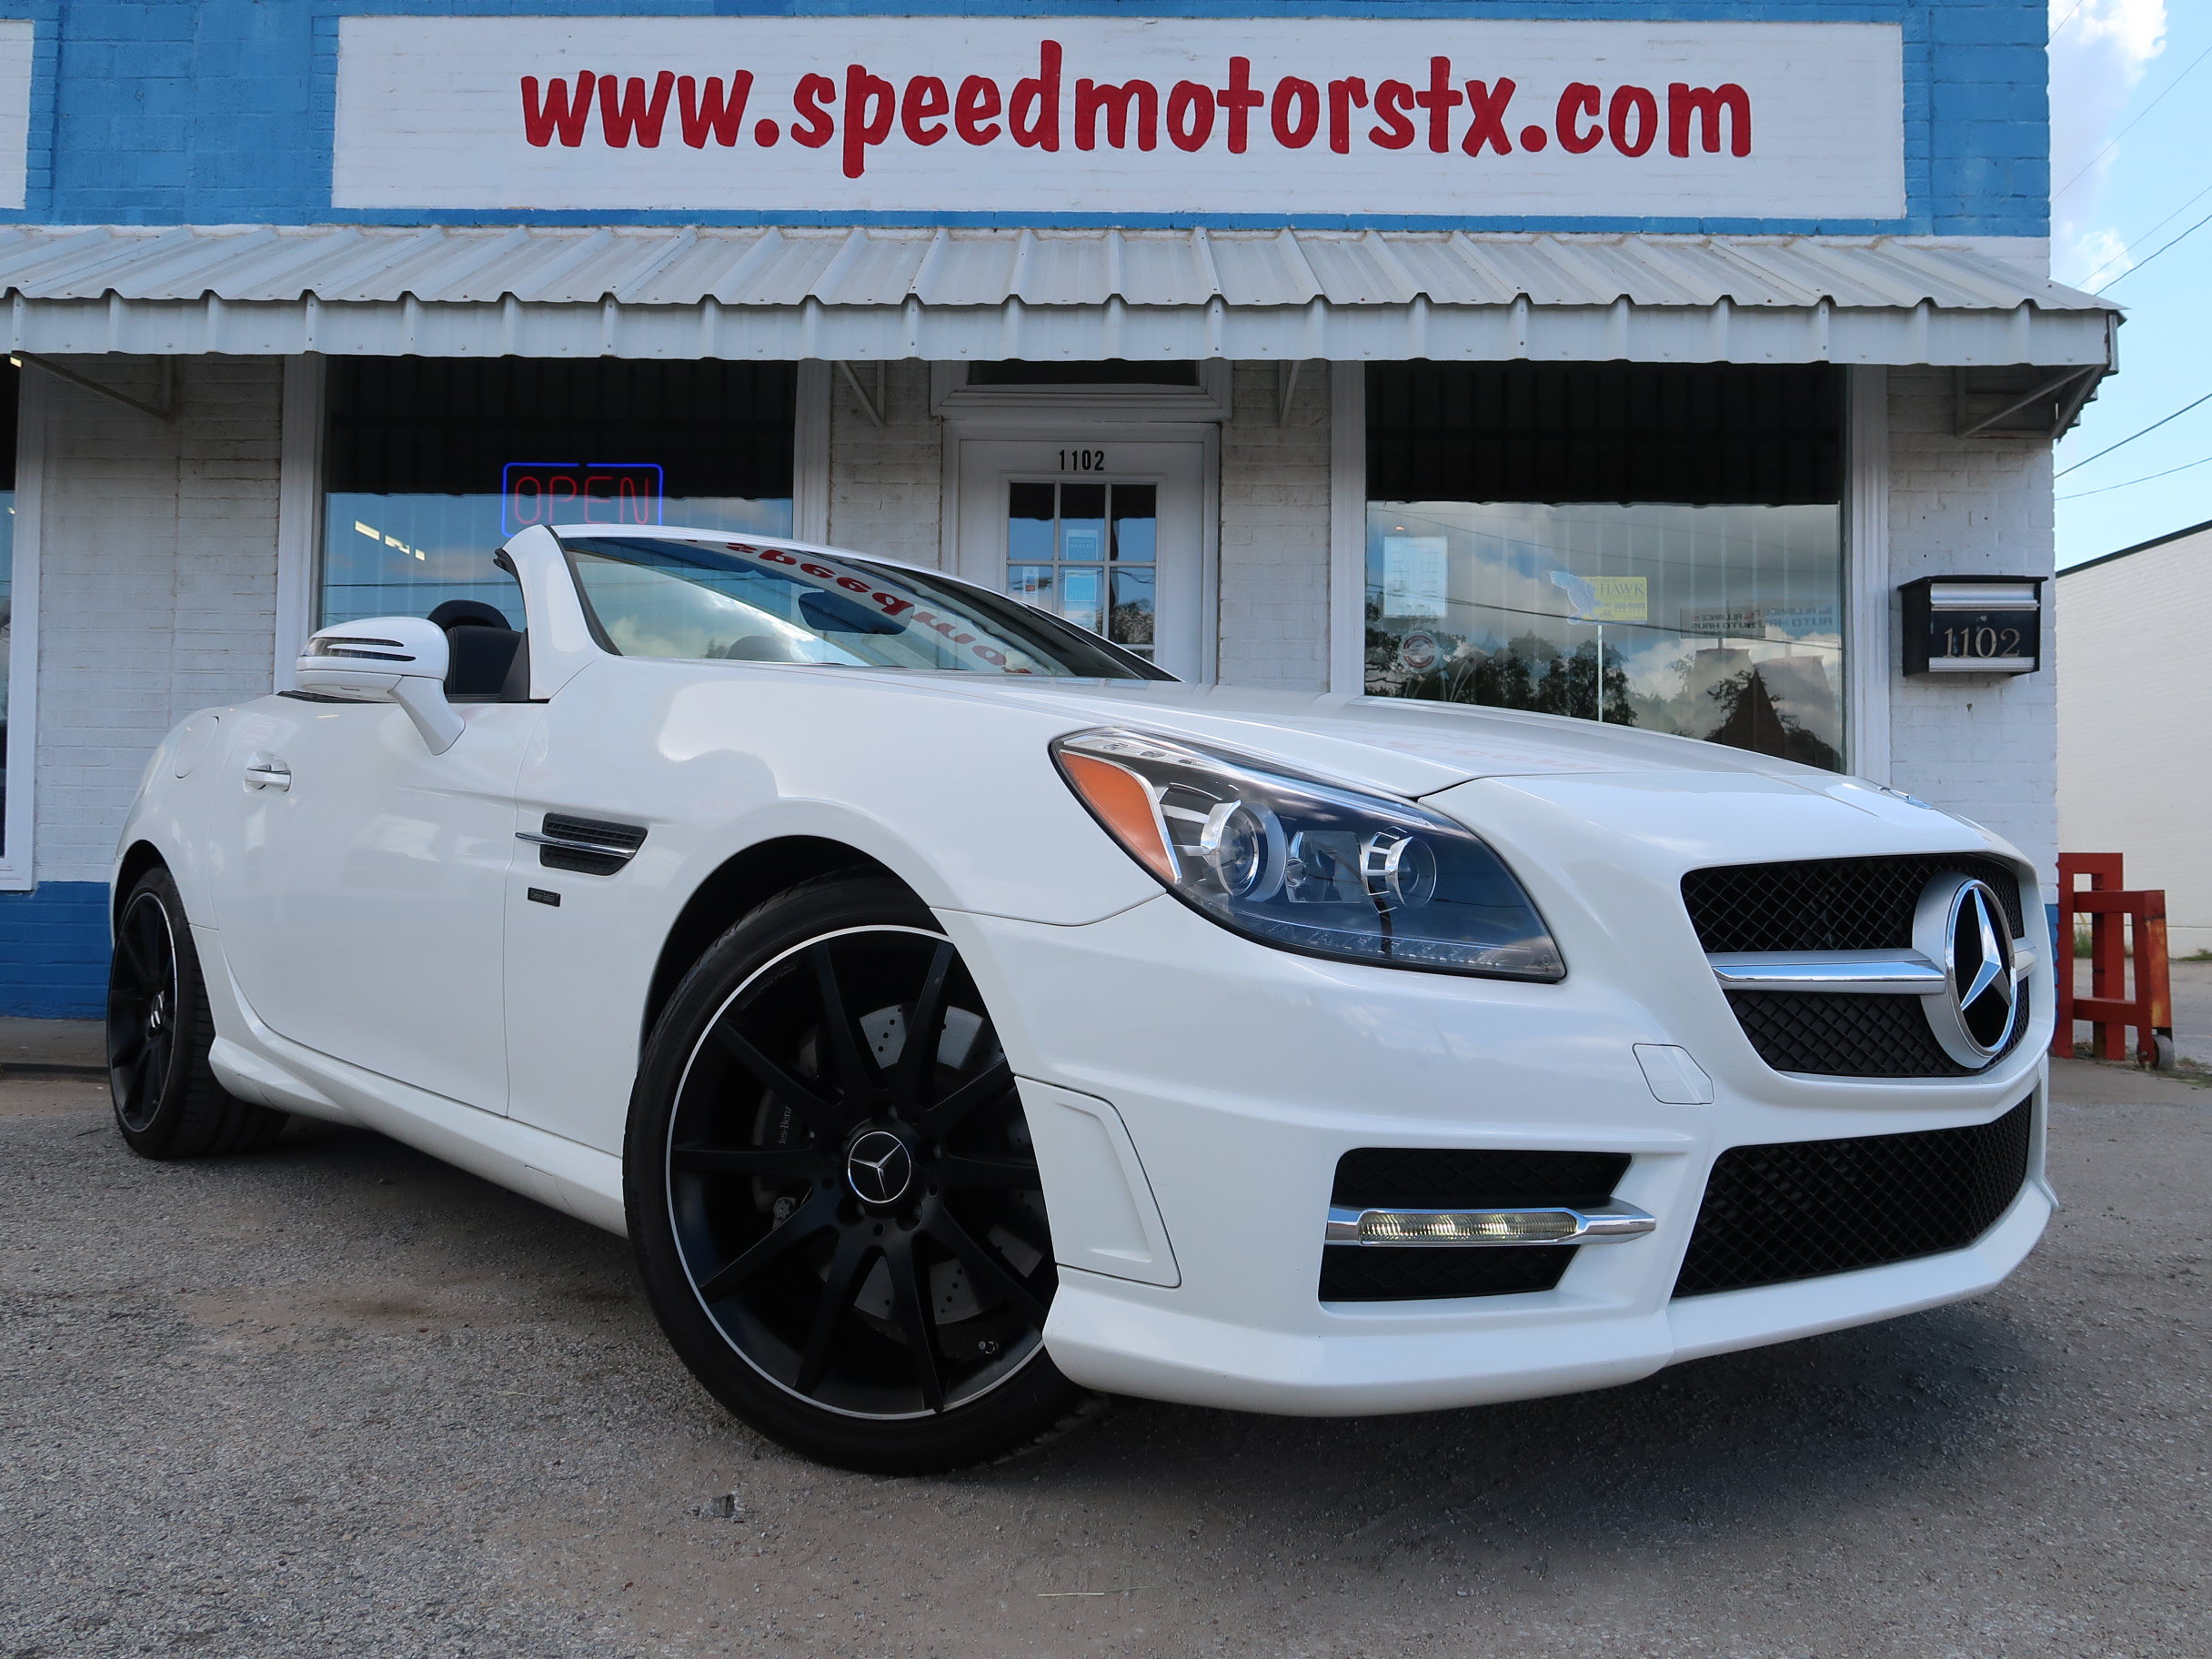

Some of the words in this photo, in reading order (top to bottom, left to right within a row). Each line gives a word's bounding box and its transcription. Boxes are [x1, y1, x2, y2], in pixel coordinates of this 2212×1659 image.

[522, 41, 1750, 177] www.speedmotorstx.com
[1059, 449, 1105, 471] 1102
[514, 476, 650, 524] OPEN
[1600, 583, 1645, 595] HAWK
[1943, 627, 2022, 658] 1102
